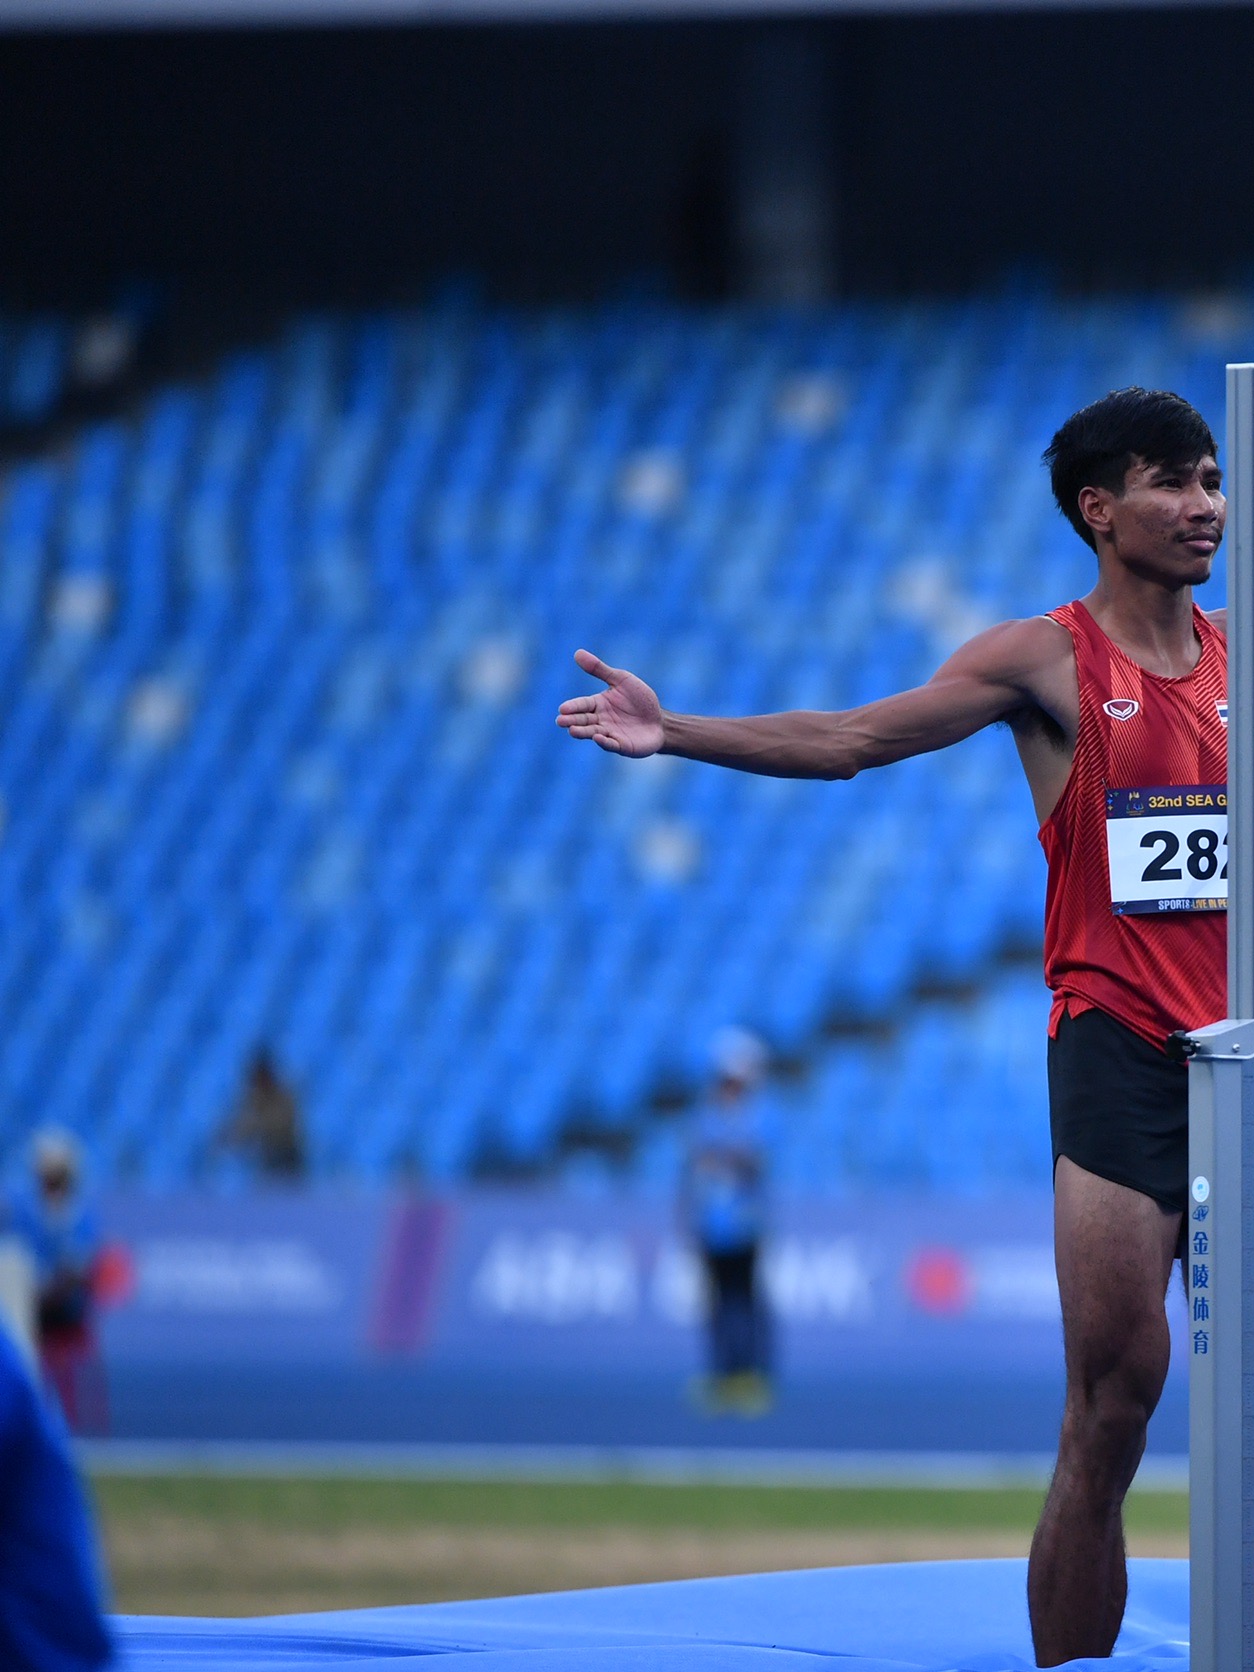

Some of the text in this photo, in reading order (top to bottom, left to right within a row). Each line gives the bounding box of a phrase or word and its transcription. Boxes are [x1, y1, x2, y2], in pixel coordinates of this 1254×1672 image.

[1148, 795, 1182, 808] 32nd
[1185, 794, 1213, 806] SEA
[1139, 828, 1228, 882] 28
[1192, 1231, 1210, 1355] 金陵体育
